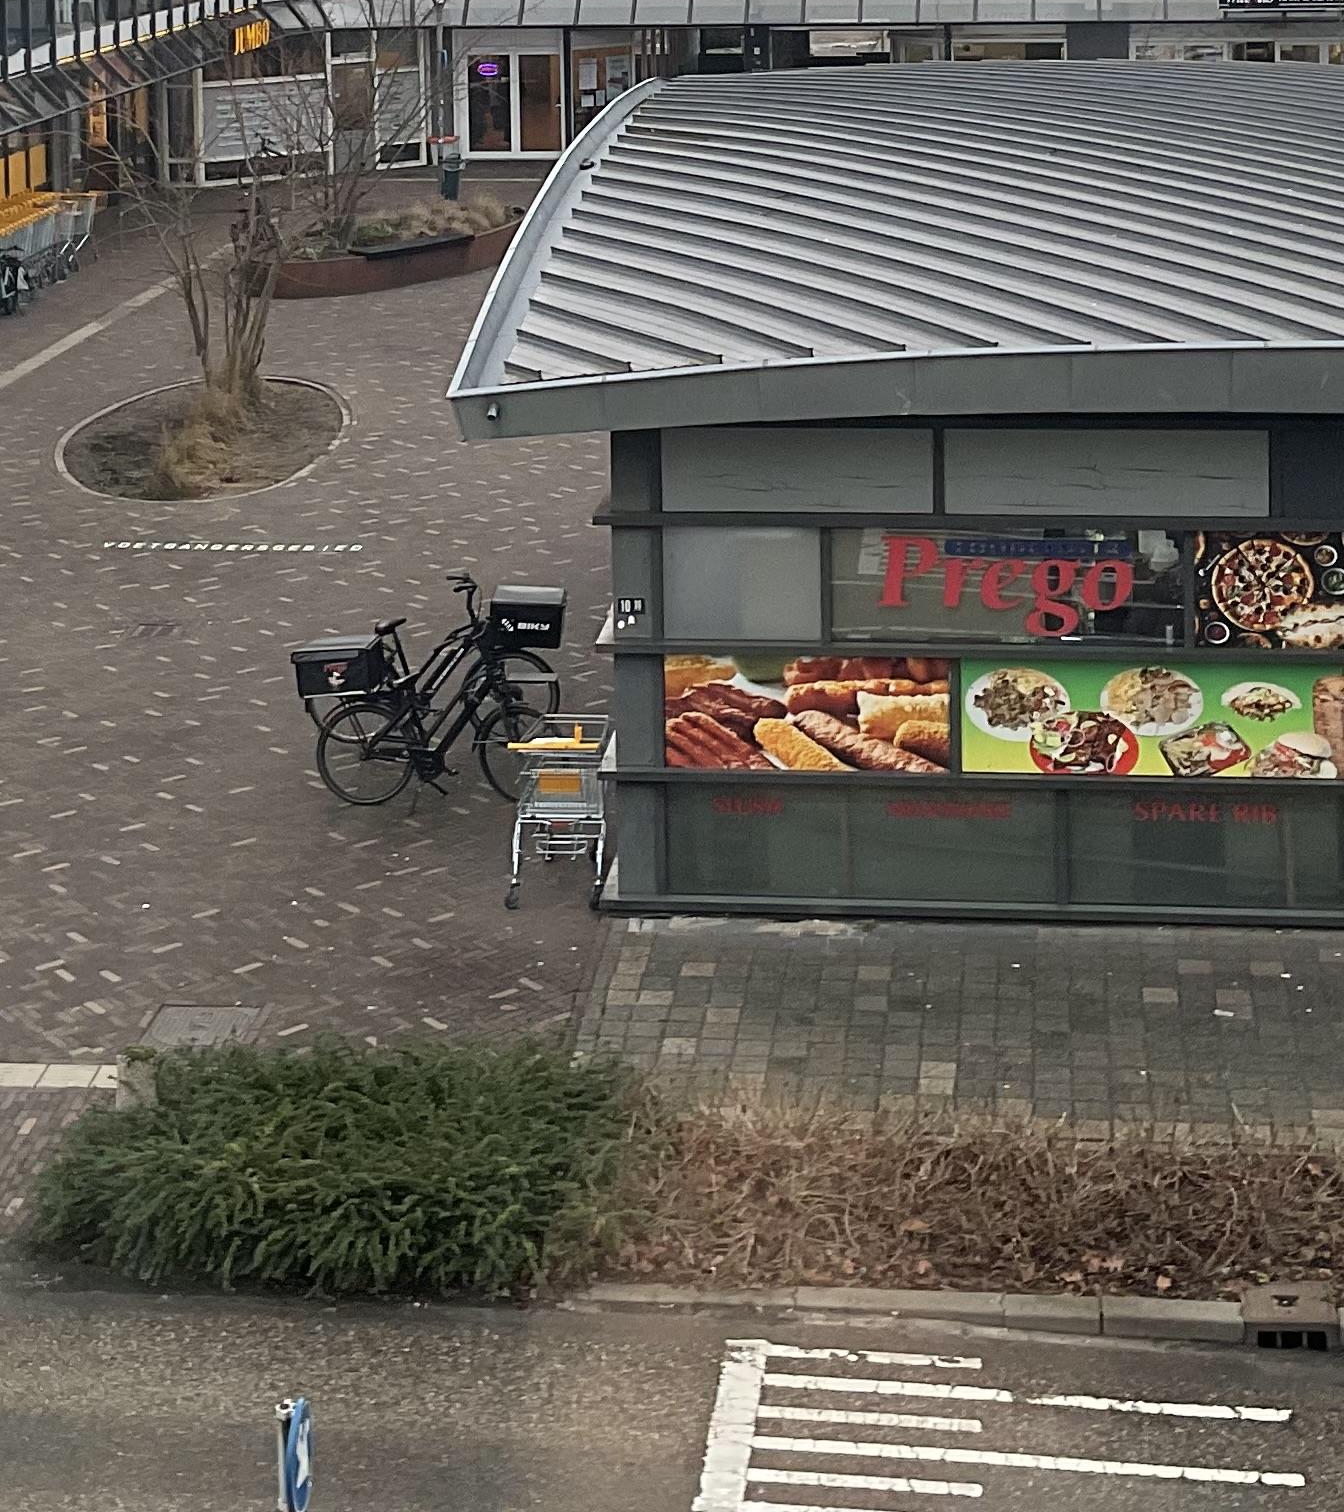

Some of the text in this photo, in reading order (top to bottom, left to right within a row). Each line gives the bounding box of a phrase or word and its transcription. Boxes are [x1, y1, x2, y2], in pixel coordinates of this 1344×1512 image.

[234, 18, 270, 55] JUMBO
[876, 534, 1134, 638] Prego
[620, 599, 631, 613] 10
